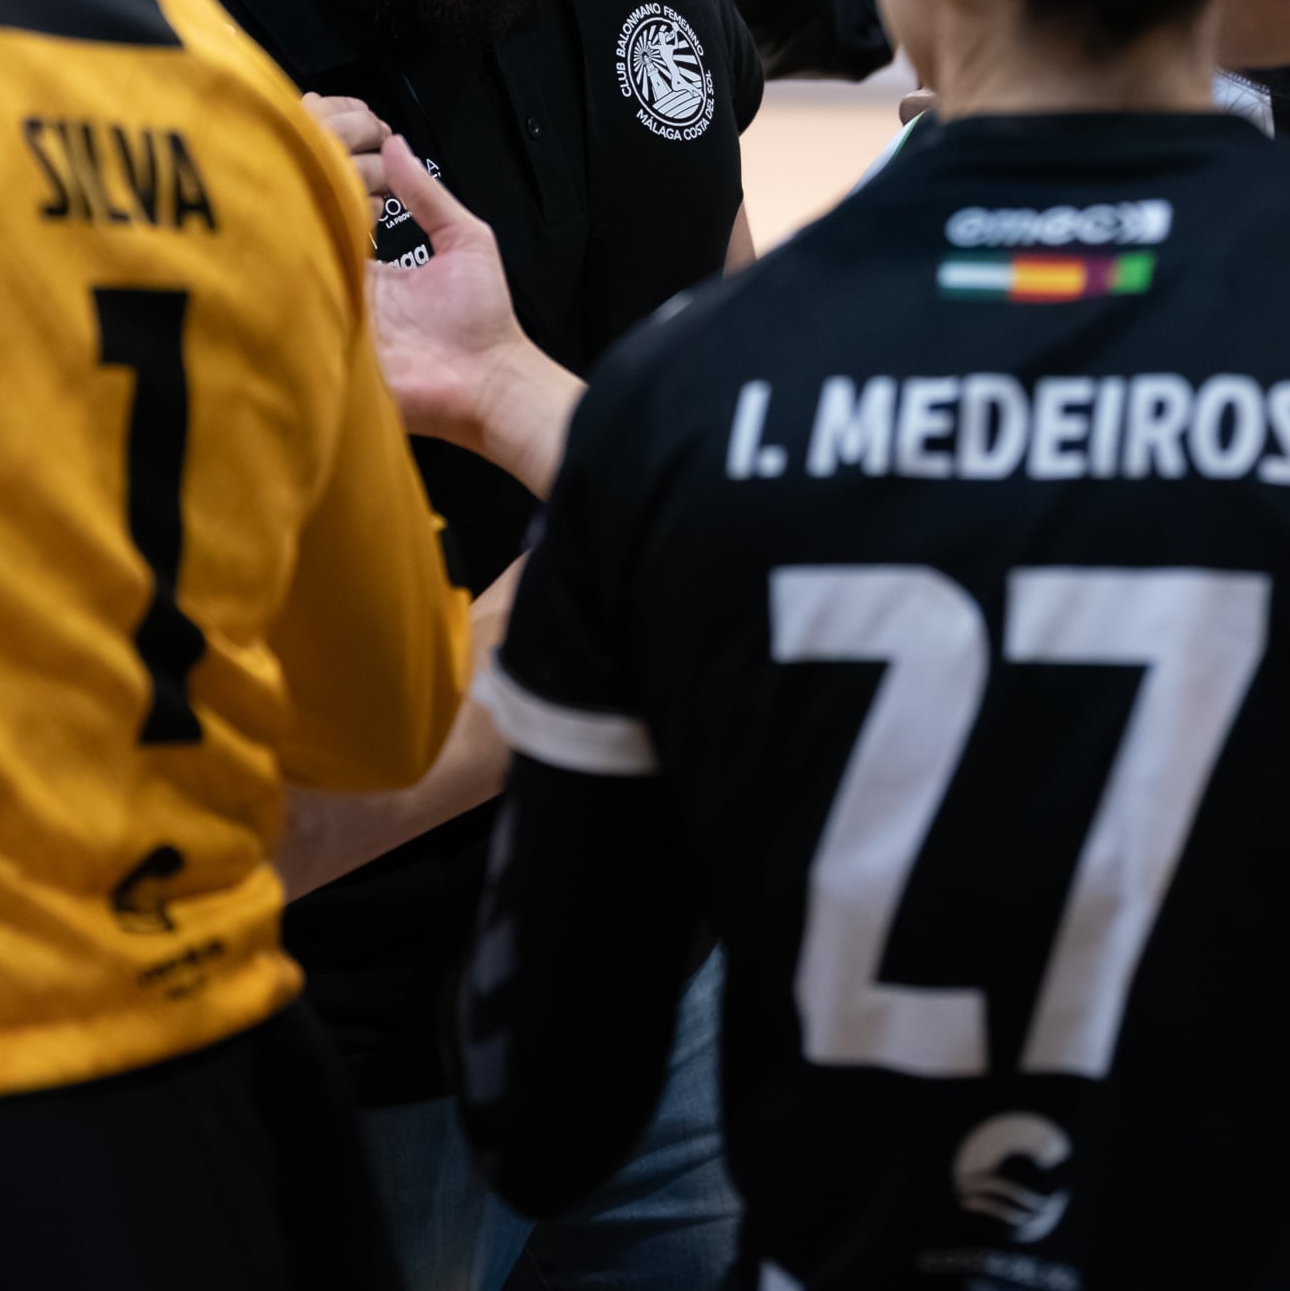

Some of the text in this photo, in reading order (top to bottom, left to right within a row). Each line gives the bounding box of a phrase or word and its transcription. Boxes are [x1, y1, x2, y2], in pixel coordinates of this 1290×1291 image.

[616, 3, 704, 98] CLUB BALONMANO FEMENINO
[636, 70, 715, 141] MÁLAGA COSTA DEL SOL
[23, 118, 221, 234] SILVA
[726, 379, 785, 480] I.
[91, 287, 206, 746] 1
[768, 562, 1272, 1079] 27
